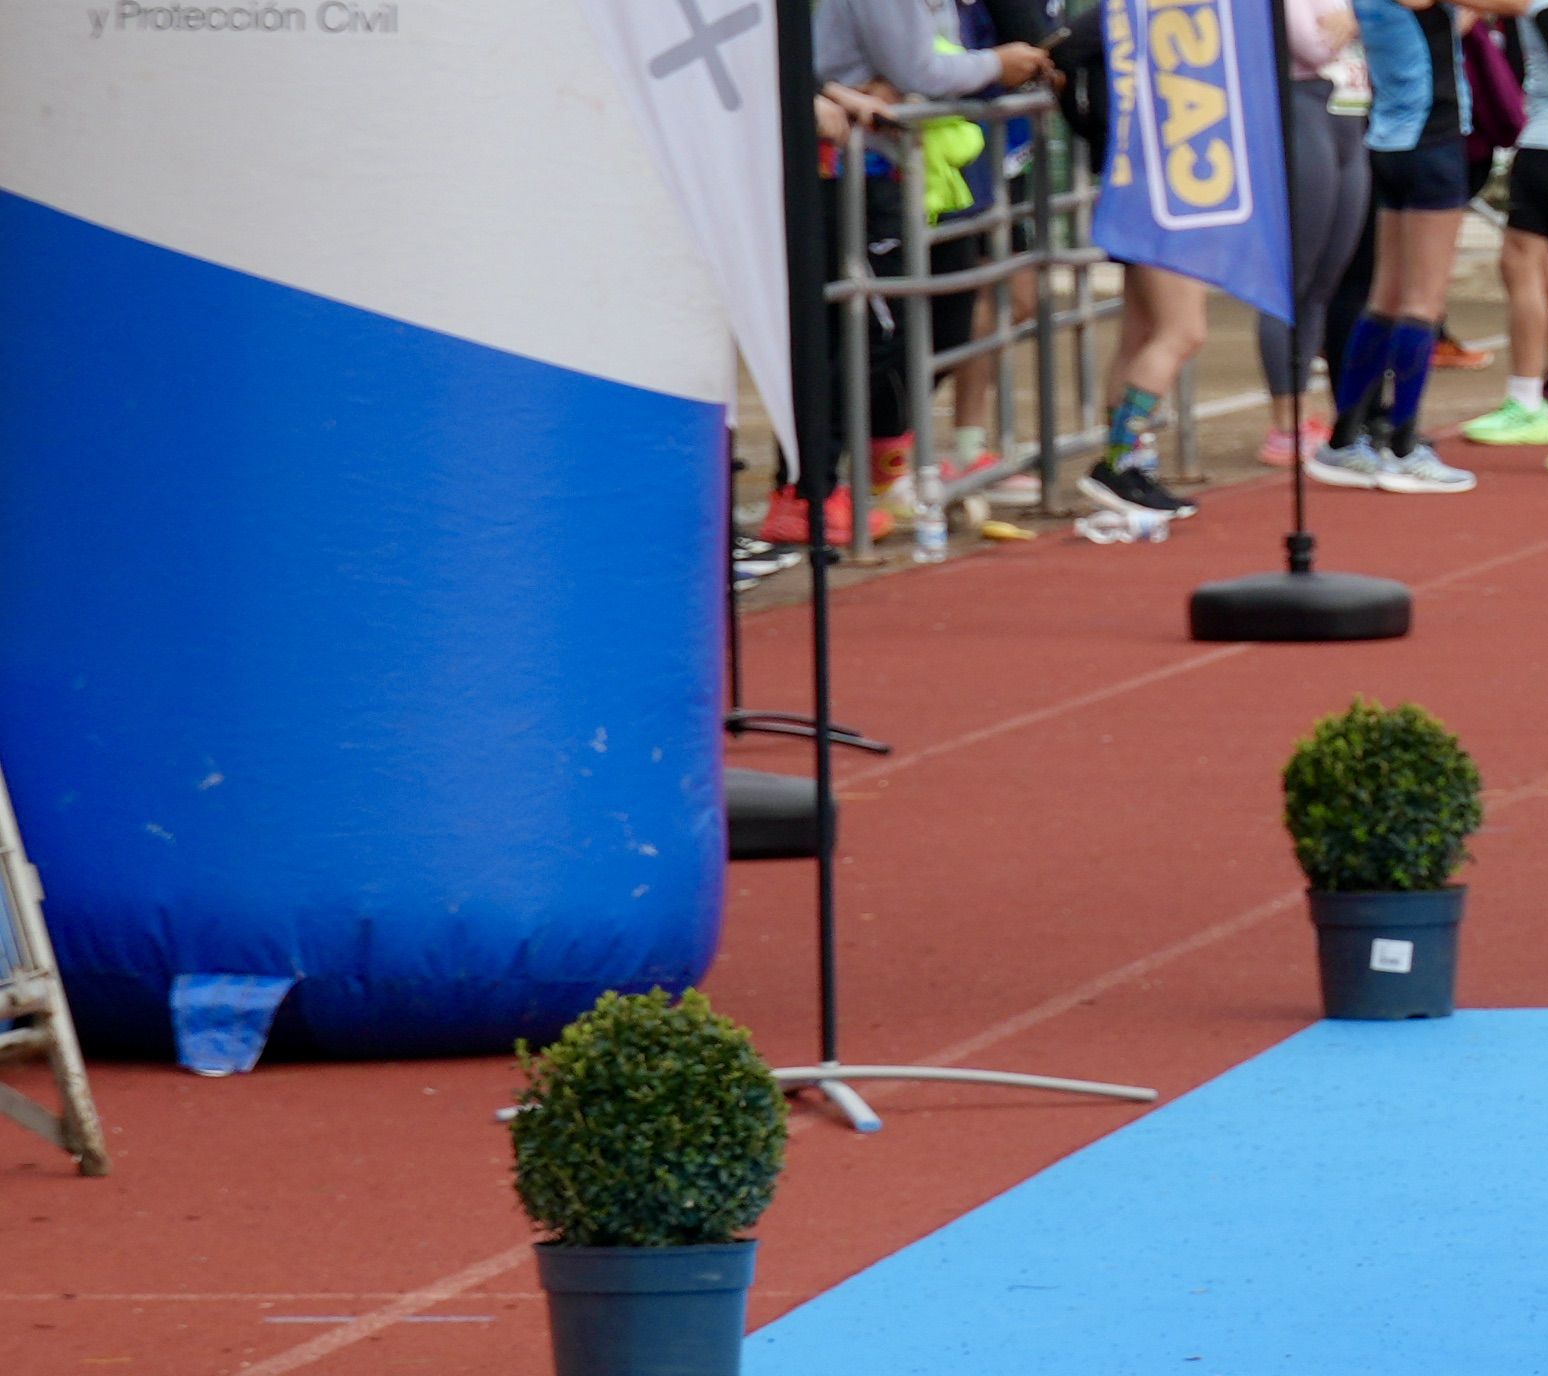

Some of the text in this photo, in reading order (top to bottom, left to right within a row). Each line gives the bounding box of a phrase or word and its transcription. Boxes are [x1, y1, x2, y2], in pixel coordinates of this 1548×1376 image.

[88, 1, 398, 37] y Protección Civil
